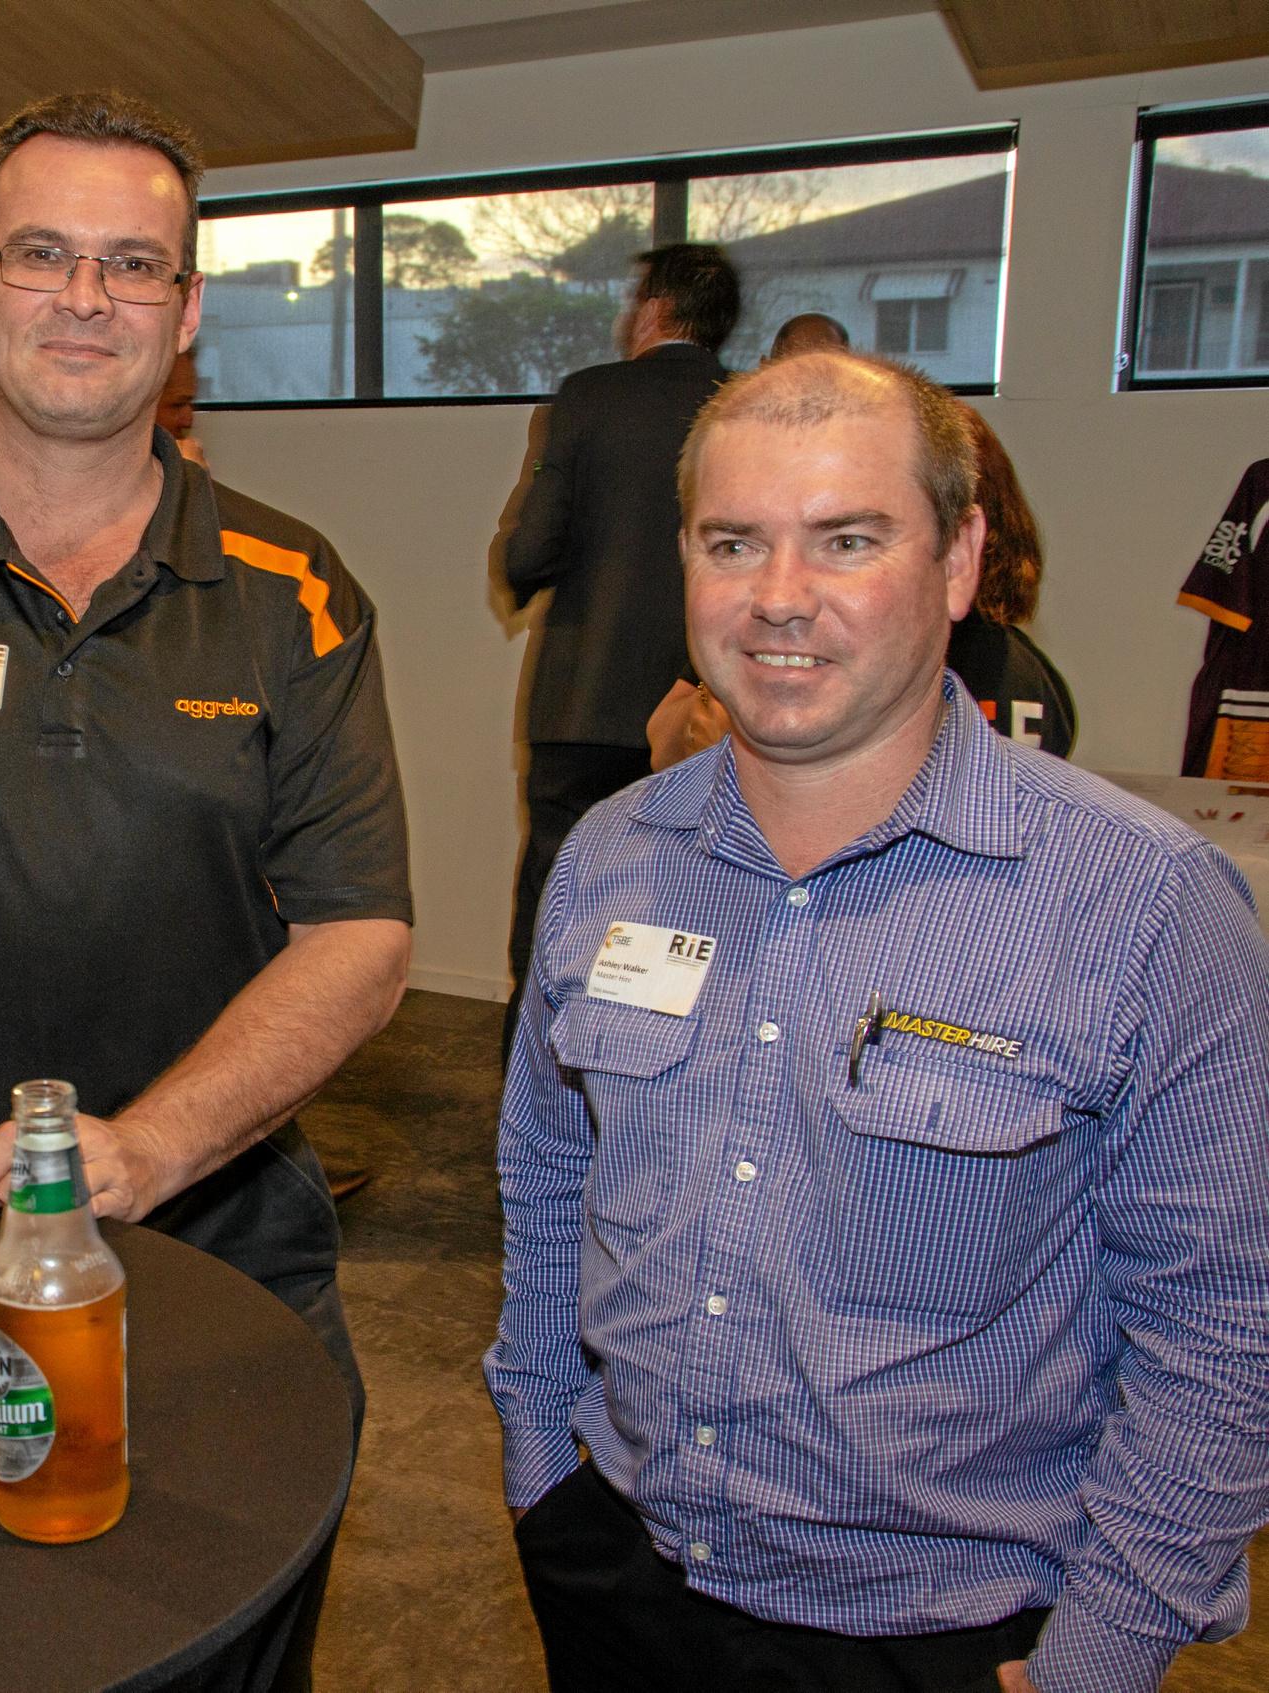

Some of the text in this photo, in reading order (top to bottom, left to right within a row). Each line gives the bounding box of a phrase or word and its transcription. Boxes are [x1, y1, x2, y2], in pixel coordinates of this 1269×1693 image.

[174, 697, 259, 720] aggreko
[668, 933, 714, 962] RiE
[598, 959, 649, 975] Ashley Walker
